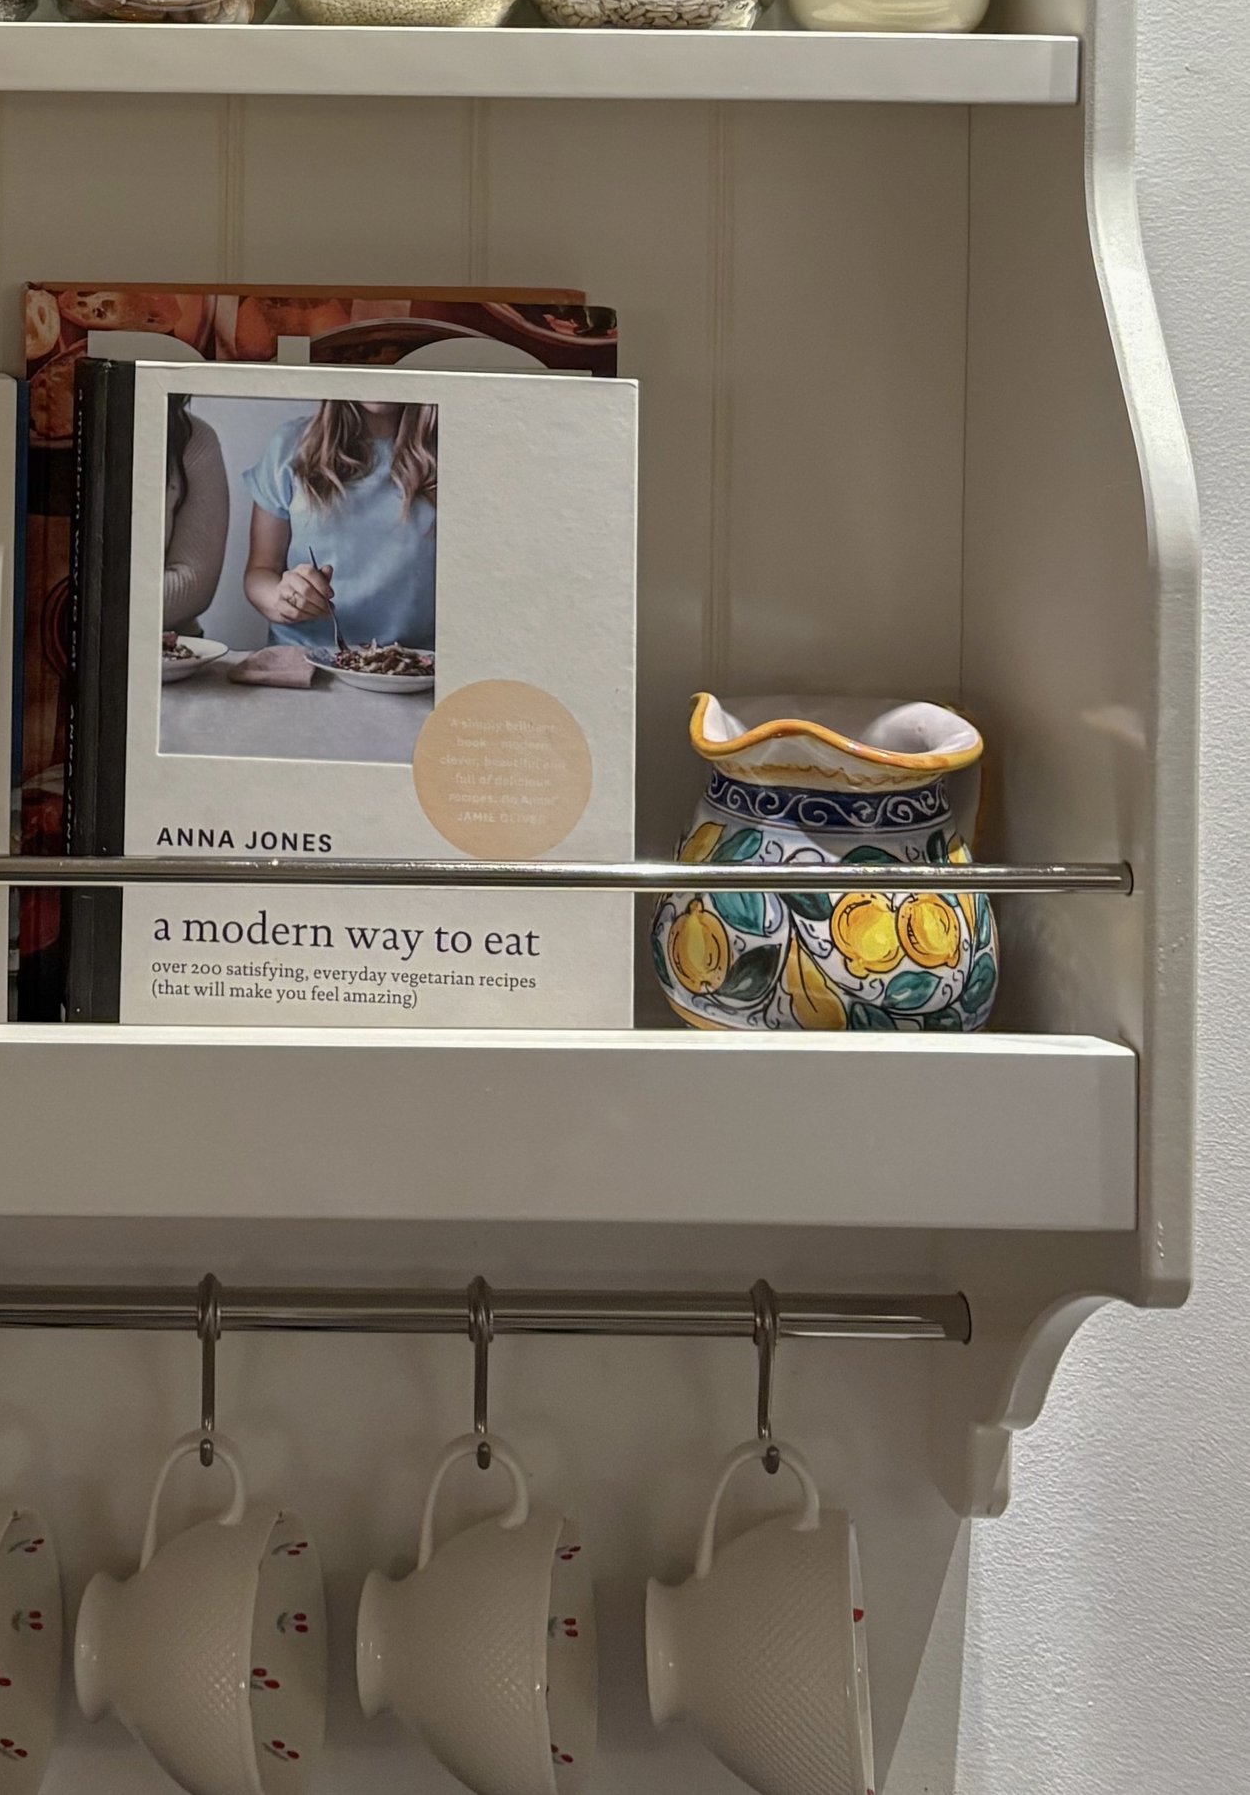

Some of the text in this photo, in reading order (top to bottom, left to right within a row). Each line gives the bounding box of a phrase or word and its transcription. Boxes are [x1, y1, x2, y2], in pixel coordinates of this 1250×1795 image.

[456, 811, 496, 823] JAMIE
[157, 827, 332, 852] ANNA JONES
[154, 910, 540, 961] a modern way to eat
[152, 962, 537, 991] over 200 satisfying, everyday vegetarian recipes
[152, 979, 417, 1010] (that will make you feel amazing)
